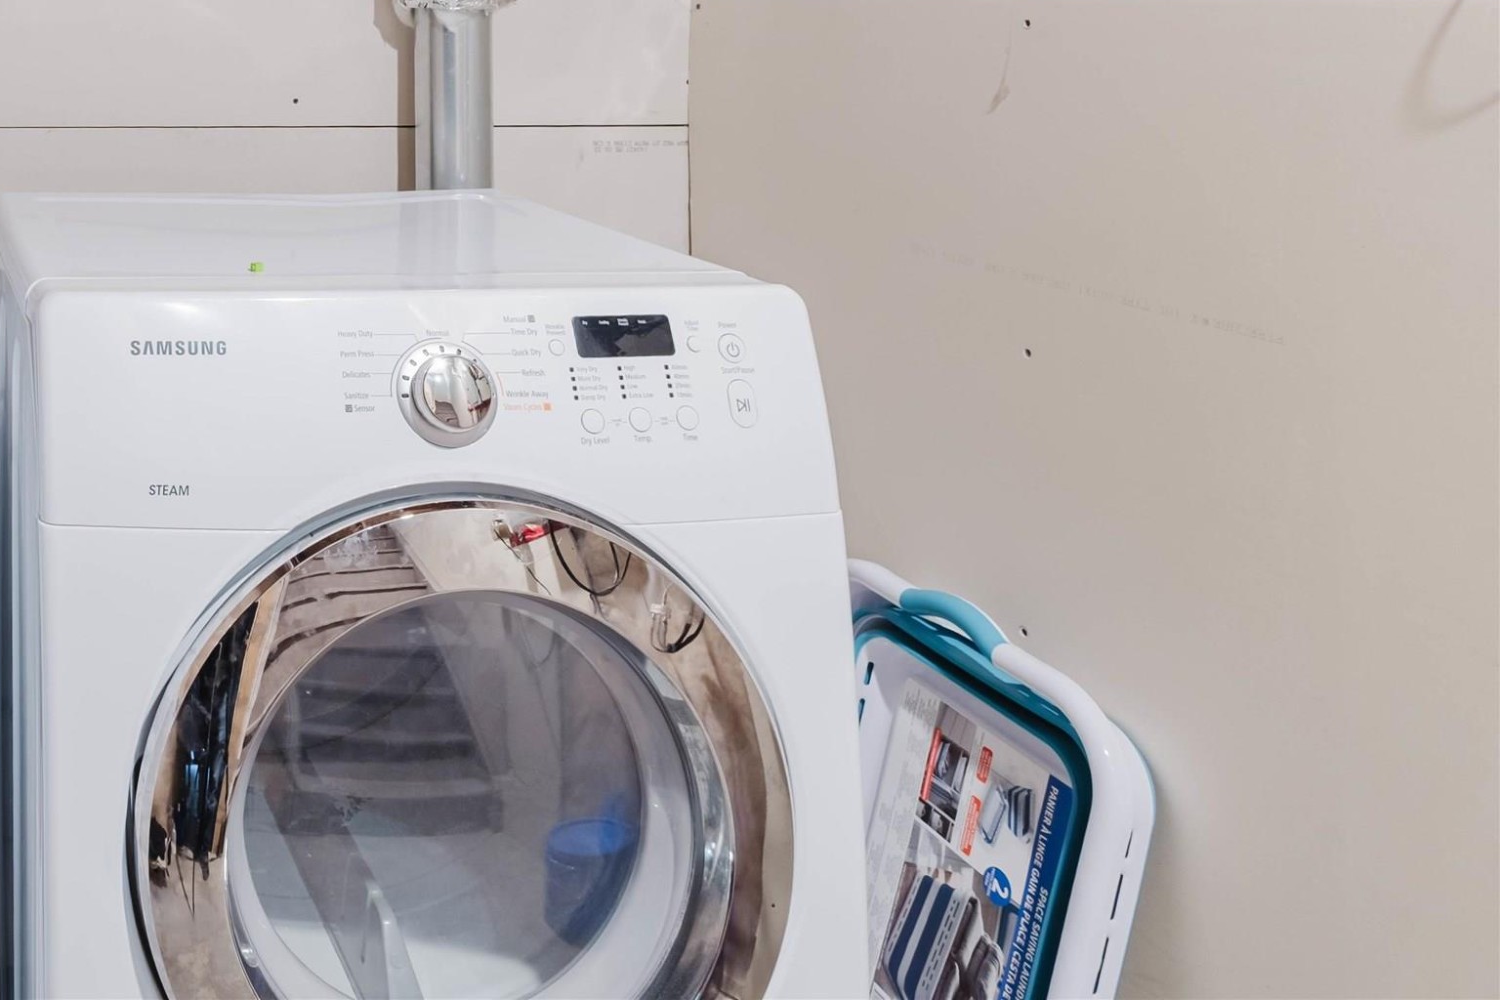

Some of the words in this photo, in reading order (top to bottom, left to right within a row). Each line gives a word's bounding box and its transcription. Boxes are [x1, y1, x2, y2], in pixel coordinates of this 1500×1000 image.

[130, 340, 227, 356] SAMSUNG
[149, 484, 189, 496] STEAM
[1046, 784, 1059, 827] PANIER
[1035, 834, 1048, 867] LINGE
[991, 875, 1010, 900] 2
[1028, 868, 1041, 897] GAIN
[1025, 895, 1034, 911] DE
[1035, 886, 1049, 923] SPACE
[1015, 910, 1030, 946] PLACE
[1026, 921, 1041, 963] SAVING
[1007, 950, 1023, 983] CESTA
